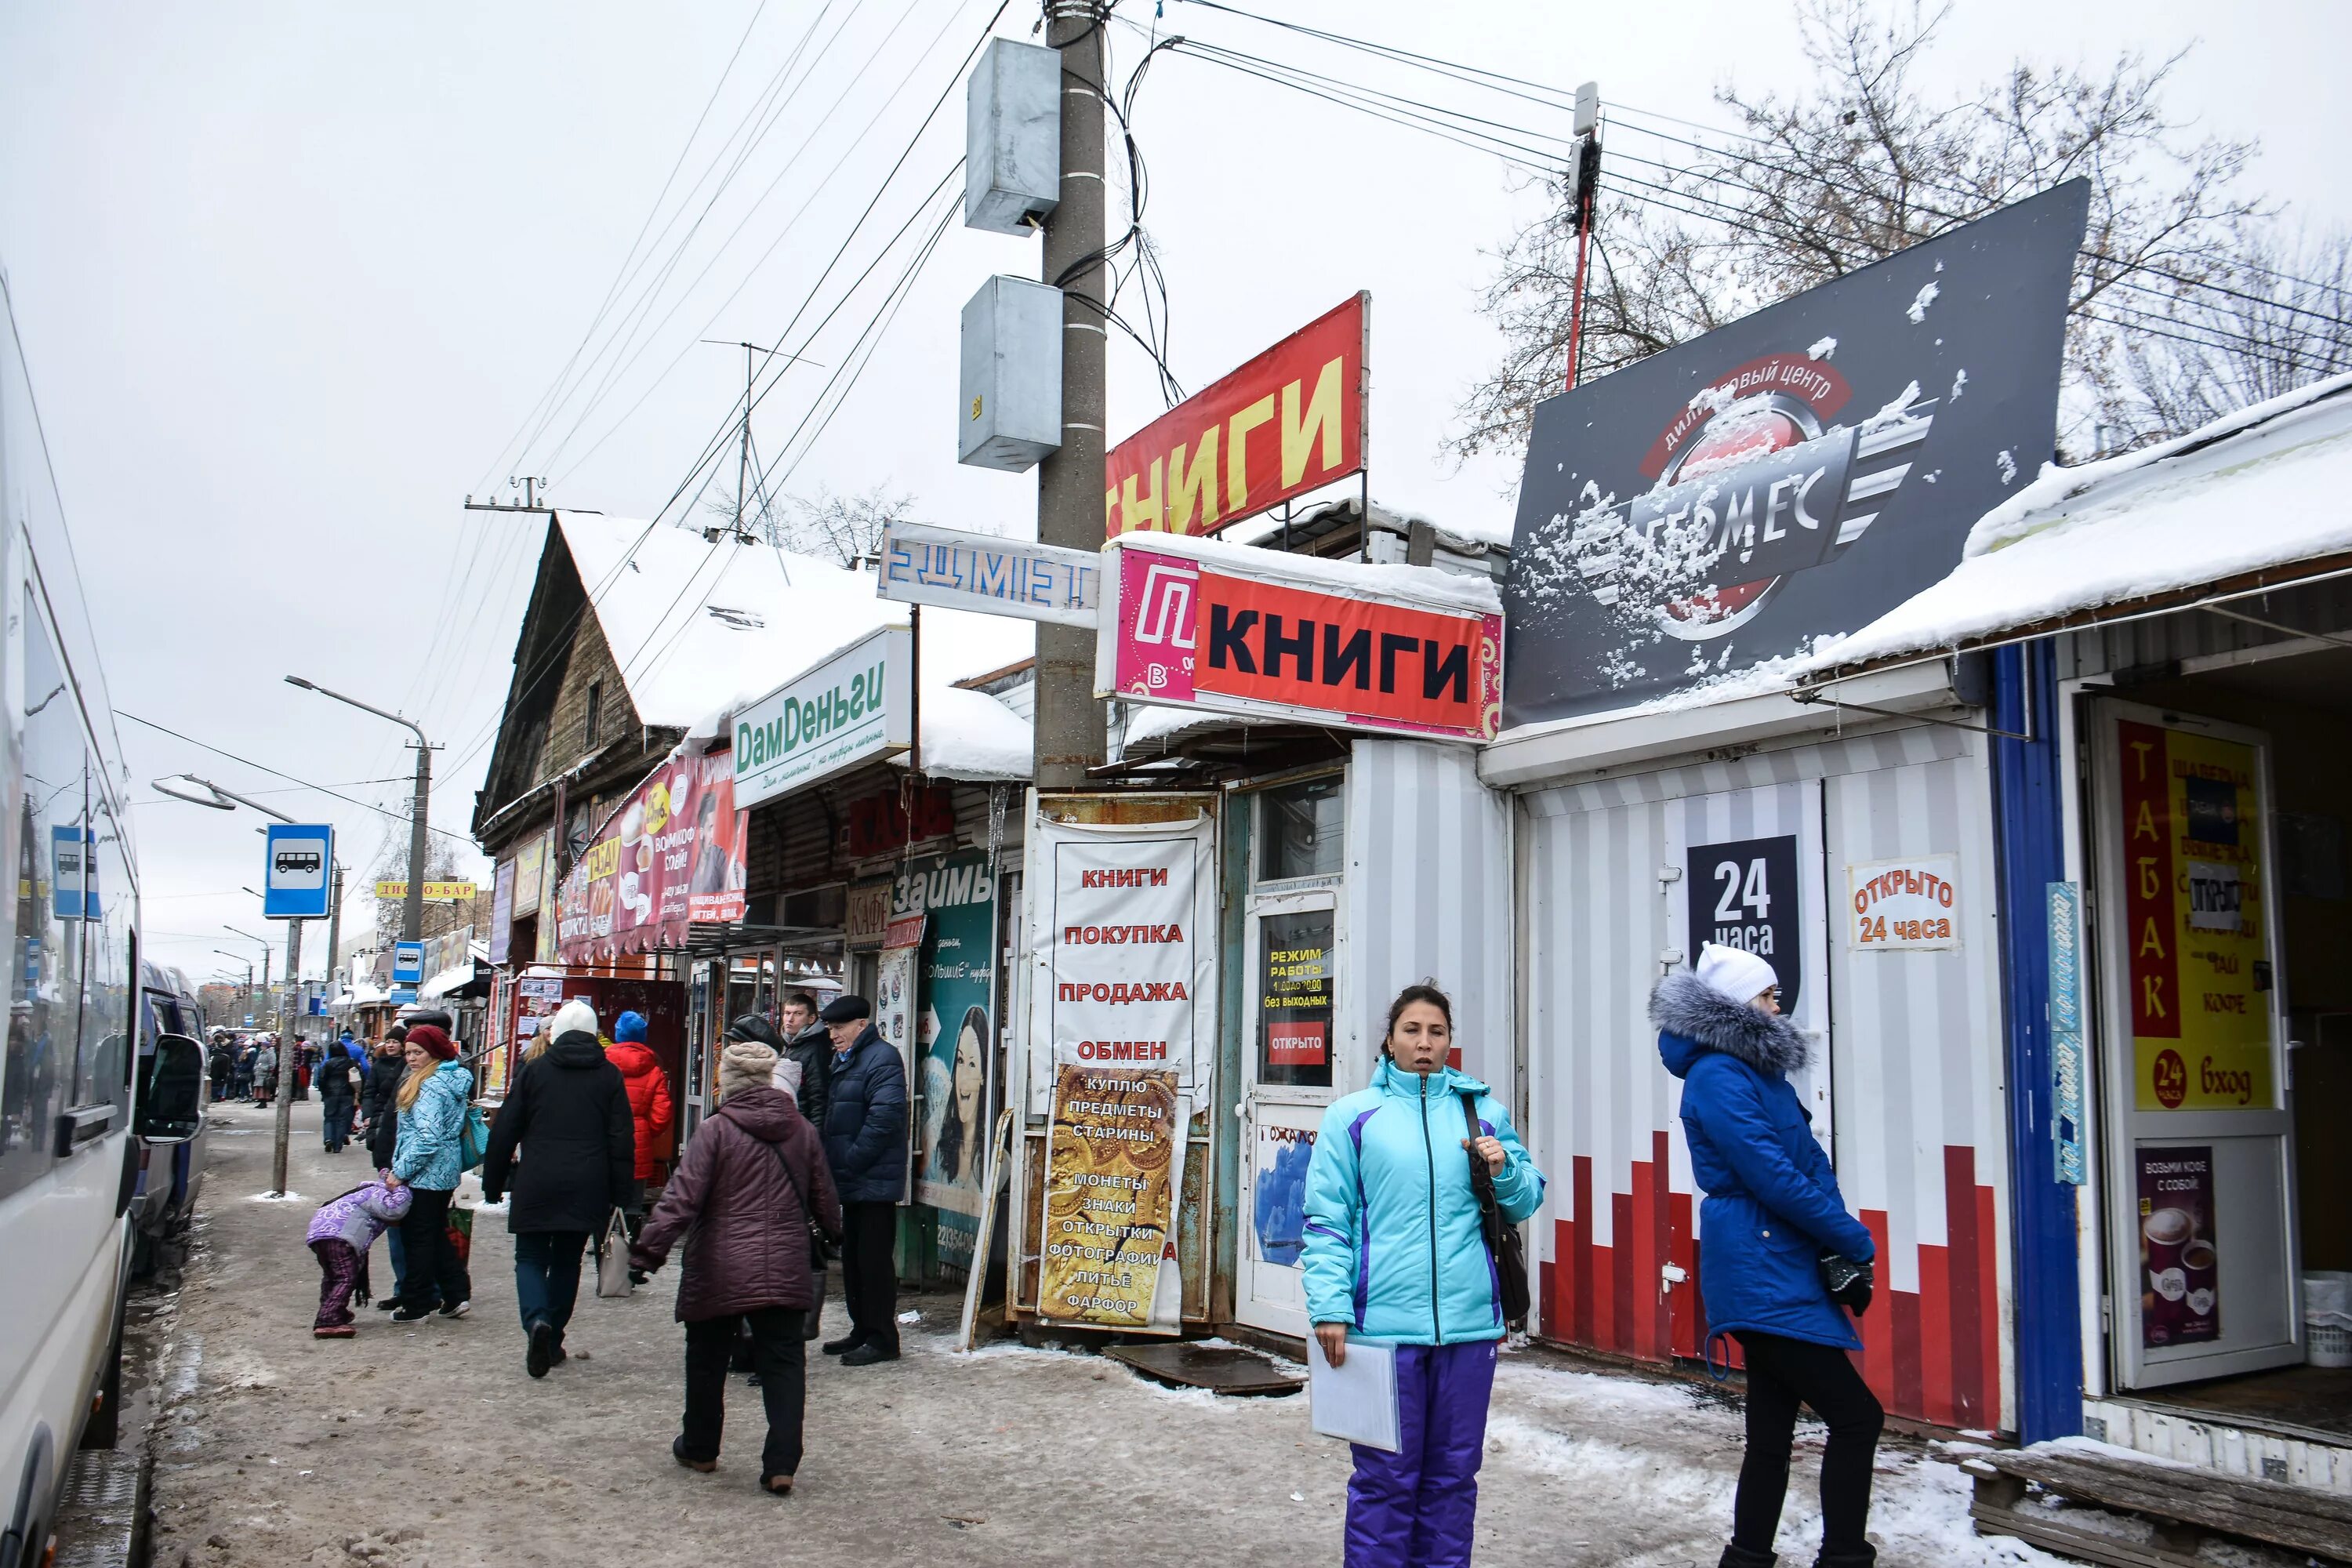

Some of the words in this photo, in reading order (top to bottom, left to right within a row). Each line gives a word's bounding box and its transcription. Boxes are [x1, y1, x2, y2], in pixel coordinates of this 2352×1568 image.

[1664, 359, 1780, 452] дилиовый
[1779, 364, 1832, 401] центр
[1208, 604, 1468, 704] КНИГИ
[1082, 868, 1167, 887] КНИГИ
[2129, 741, 2167, 1019] ТАБАК
[379, 884, 472, 896] ДИСО-БАР
[1714, 858, 1771, 921] 24
[1855, 869, 1953, 915] ОТКРЫТО
[1065, 924, 1184, 945] ПОКУПКА
[1860, 916, 1887, 942] 24
[1893, 917, 1951, 940] часа
[1715, 924, 1773, 954] часа
[1270, 949, 1322, 963] РЕЖИМ
[1270, 965, 1322, 978] РАБОТЫ
[1058, 982, 1189, 1006] ПРОДАЖА
[1264, 996, 1281, 1008] без
[2203, 993, 2247, 1014] КОФЕ
[1077, 1041, 1167, 1060] ОБМЕН
[1272, 1036, 1323, 1050] ОТКРЫТО
[2158, 1058, 2184, 1091] 24
[1087, 1077, 1148, 1093] КУПЛЮ
[1069, 1100, 1163, 1119] ПРЕДМЕТЫ
[1073, 1125, 1154, 1142] СТАРИНЫ
[1073, 1173, 1147, 1190] МОНЕТЫ
[1082, 1198, 1136, 1214] ЗНАКИ
[1062, 1221, 1153, 1240] ОТКРЫТКИ
[1048, 1243, 1161, 1265] ФОТОГРАФИИ
[1075, 1270, 1132, 1288] ЛИТЬЁ
[1066, 1296, 1138, 1313] ФАРФОР
